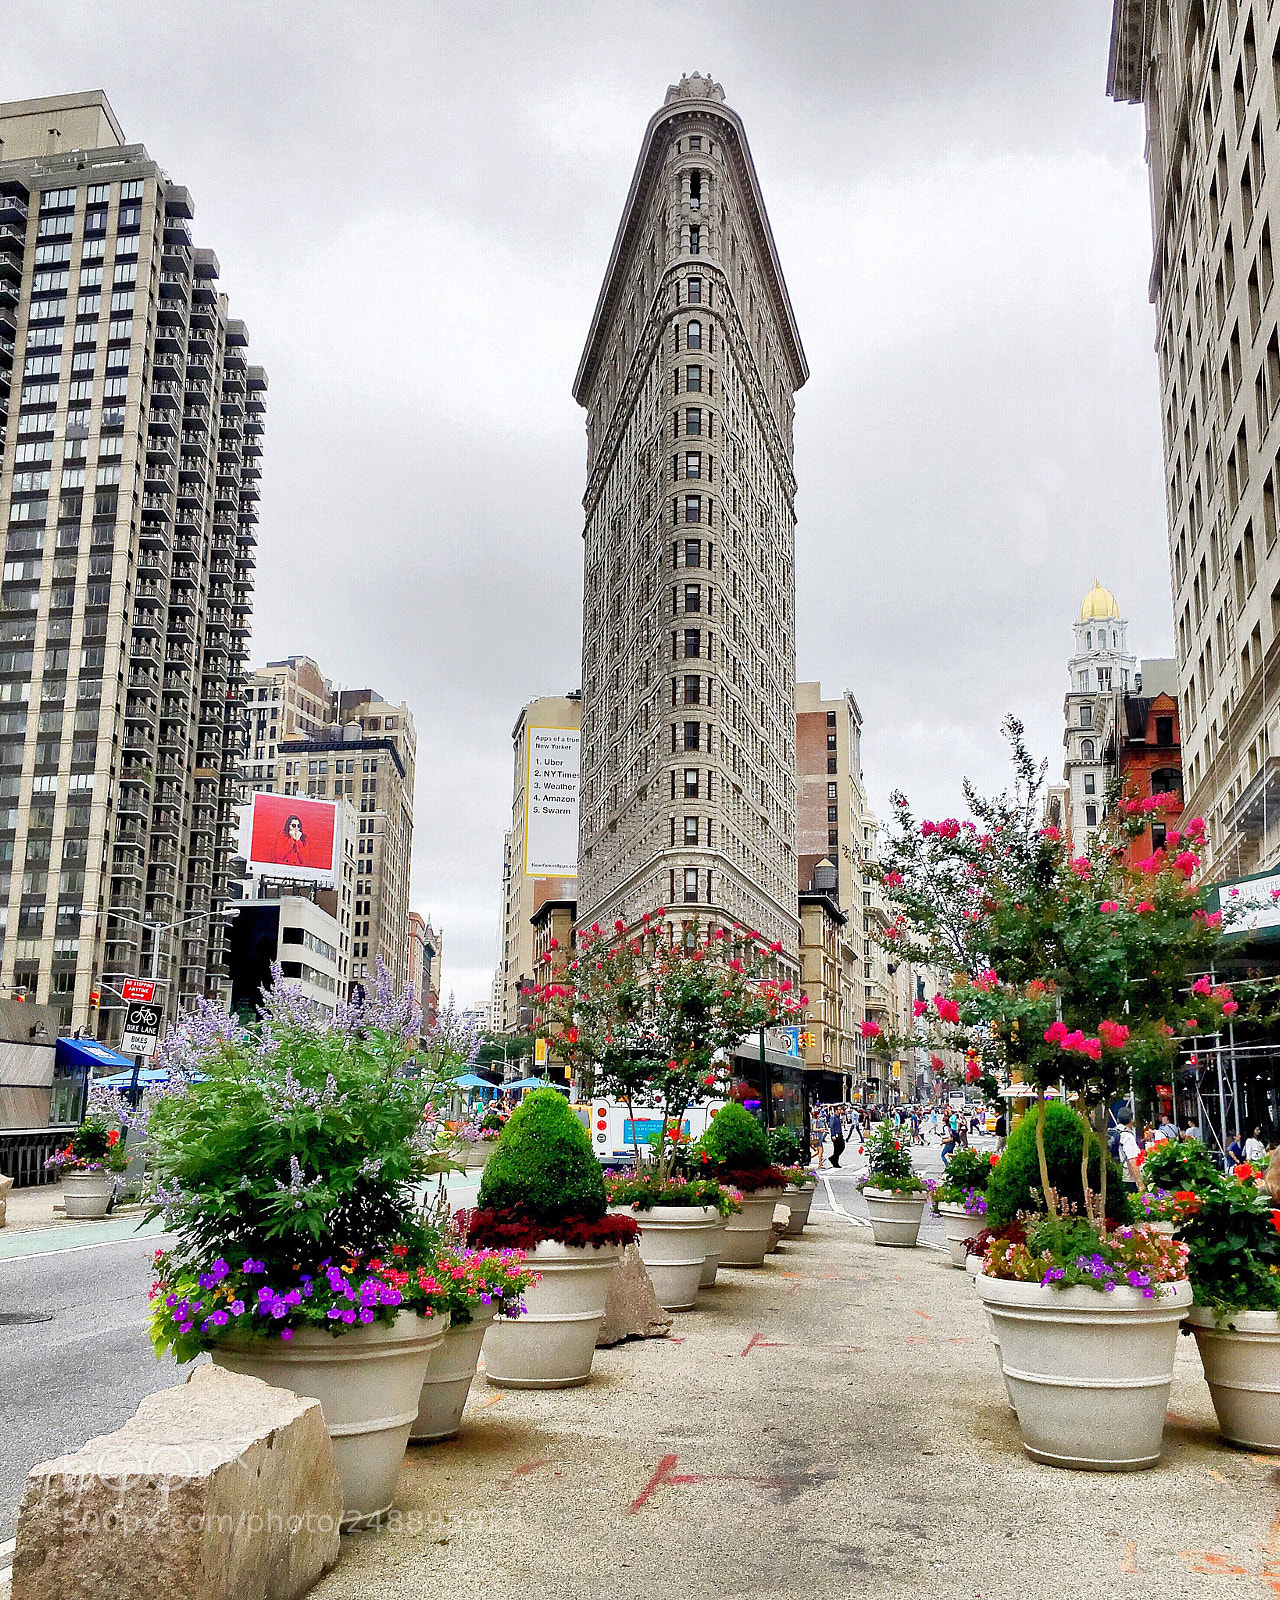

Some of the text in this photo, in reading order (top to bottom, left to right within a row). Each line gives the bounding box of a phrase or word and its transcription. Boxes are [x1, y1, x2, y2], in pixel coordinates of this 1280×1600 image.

[544, 758, 564, 766] Uber
[533, 781, 576, 790] 3. Weather
[543, 794, 576, 802] Amazon
[533, 806, 571, 814] 5. Swarm
[140, 1026, 157, 1034] LANE
[131, 1036, 148, 1044] BIKES
[130, 1043, 146, 1051] ONLY
